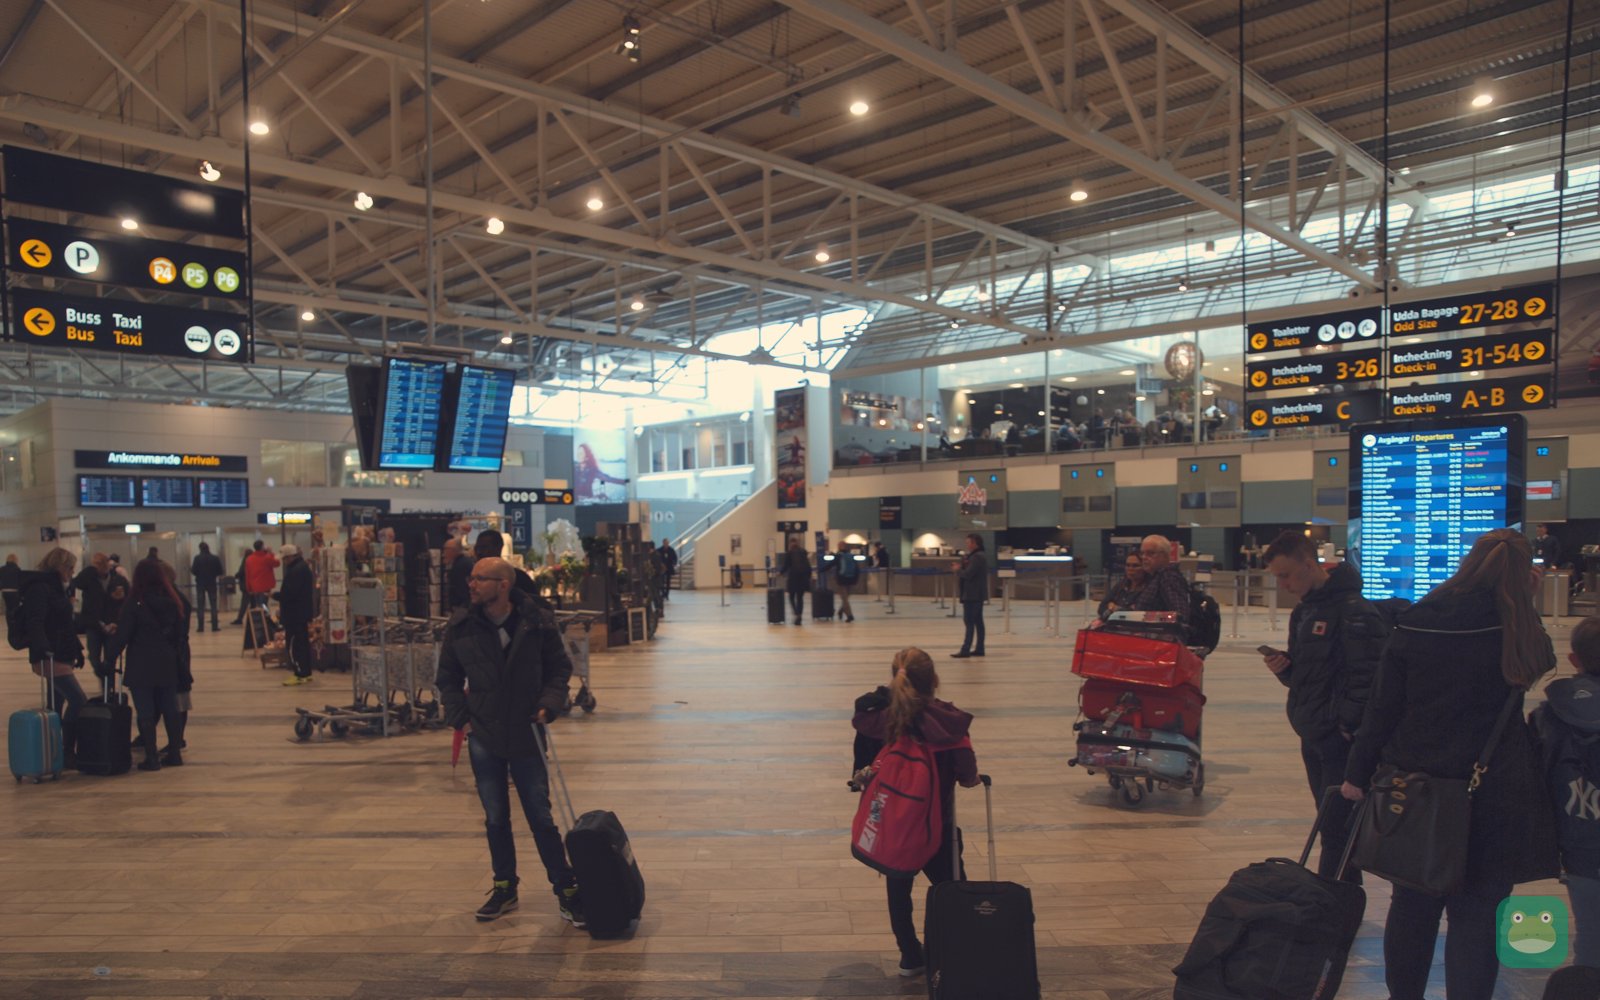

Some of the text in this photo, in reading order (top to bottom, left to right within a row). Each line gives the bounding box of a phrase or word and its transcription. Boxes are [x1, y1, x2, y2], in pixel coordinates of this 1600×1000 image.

[76, 248, 89, 266] P
[154, 267, 172, 281] P4
[185, 268, 205, 282] P5
[217, 272, 235, 287] P6
[66, 308, 142, 330] Buss Taxi
[1393, 304, 1459, 322] Udda Bagage
[1459, 299, 1519, 325] 27-28
[1393, 318, 1438, 334] Odd Size
[66, 326, 143, 347] Bus Taxi
[1273, 336, 1301, 347] Toilets
[1393, 347, 1453, 363] Incheckning
[1460, 343, 1521, 368] 31-54
[1272, 362, 1323, 376] Incheckning
[1336, 358, 1378, 380] 3-26
[1393, 360, 1437, 374] Check-in
[1393, 391, 1452, 406] Incheckning
[1272, 402, 1323, 416] Incheckning
[1336, 401, 1351, 420] C
[1393, 403, 1436, 416] Check-in
[1415, 433, 1455, 443] Departures
[1537, 447, 1549, 456] 12
[108, 452, 221, 467] Ankommande Arrivals
